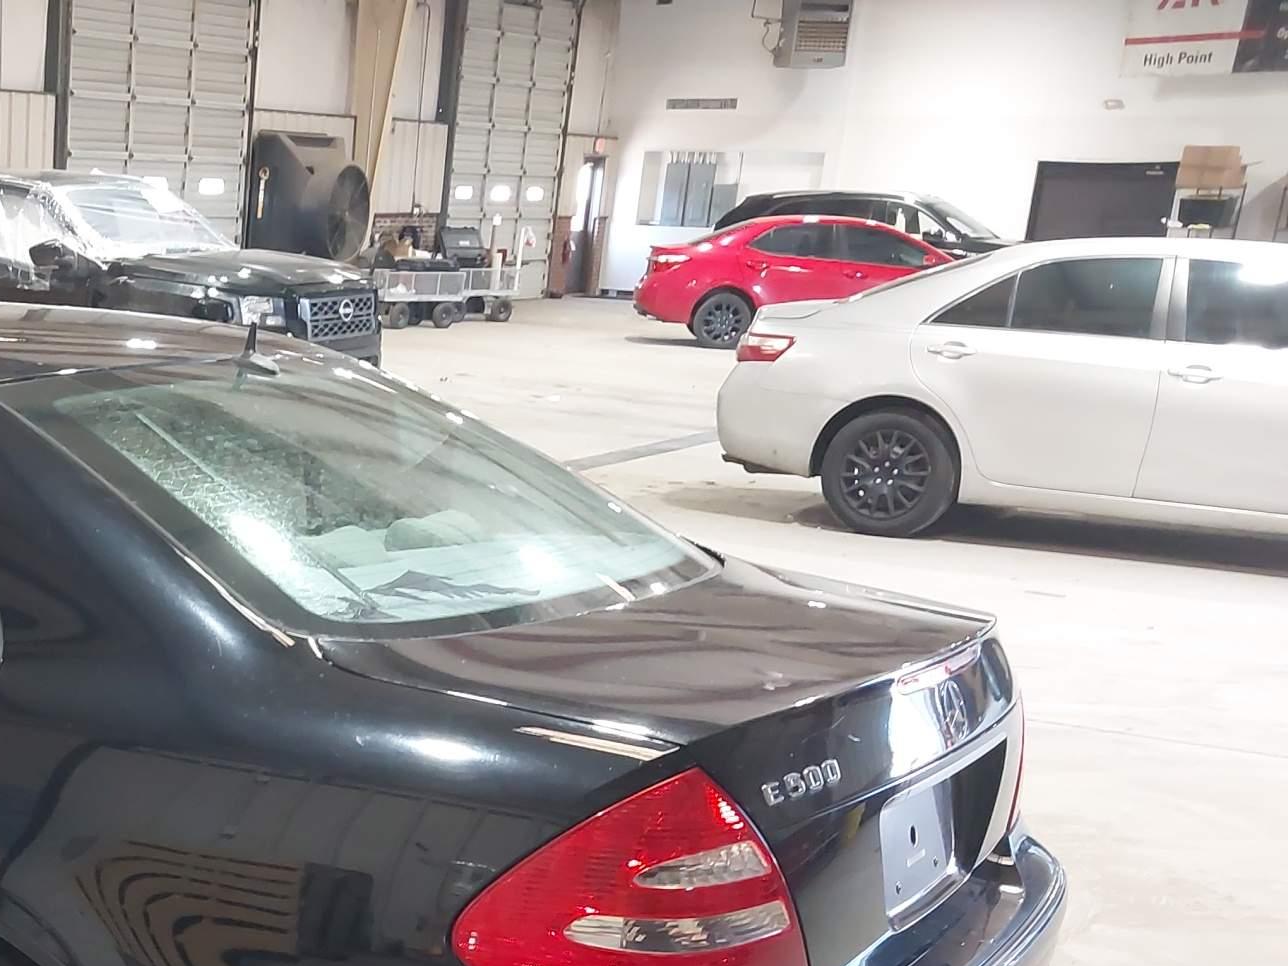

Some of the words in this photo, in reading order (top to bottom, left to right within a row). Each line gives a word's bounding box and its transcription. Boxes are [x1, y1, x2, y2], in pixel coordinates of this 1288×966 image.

[1143, 53, 1173, 68] High
[1178, 51, 1213, 64] Point
[761, 781, 785, 806] E
[783, 759, 841, 798] 500
